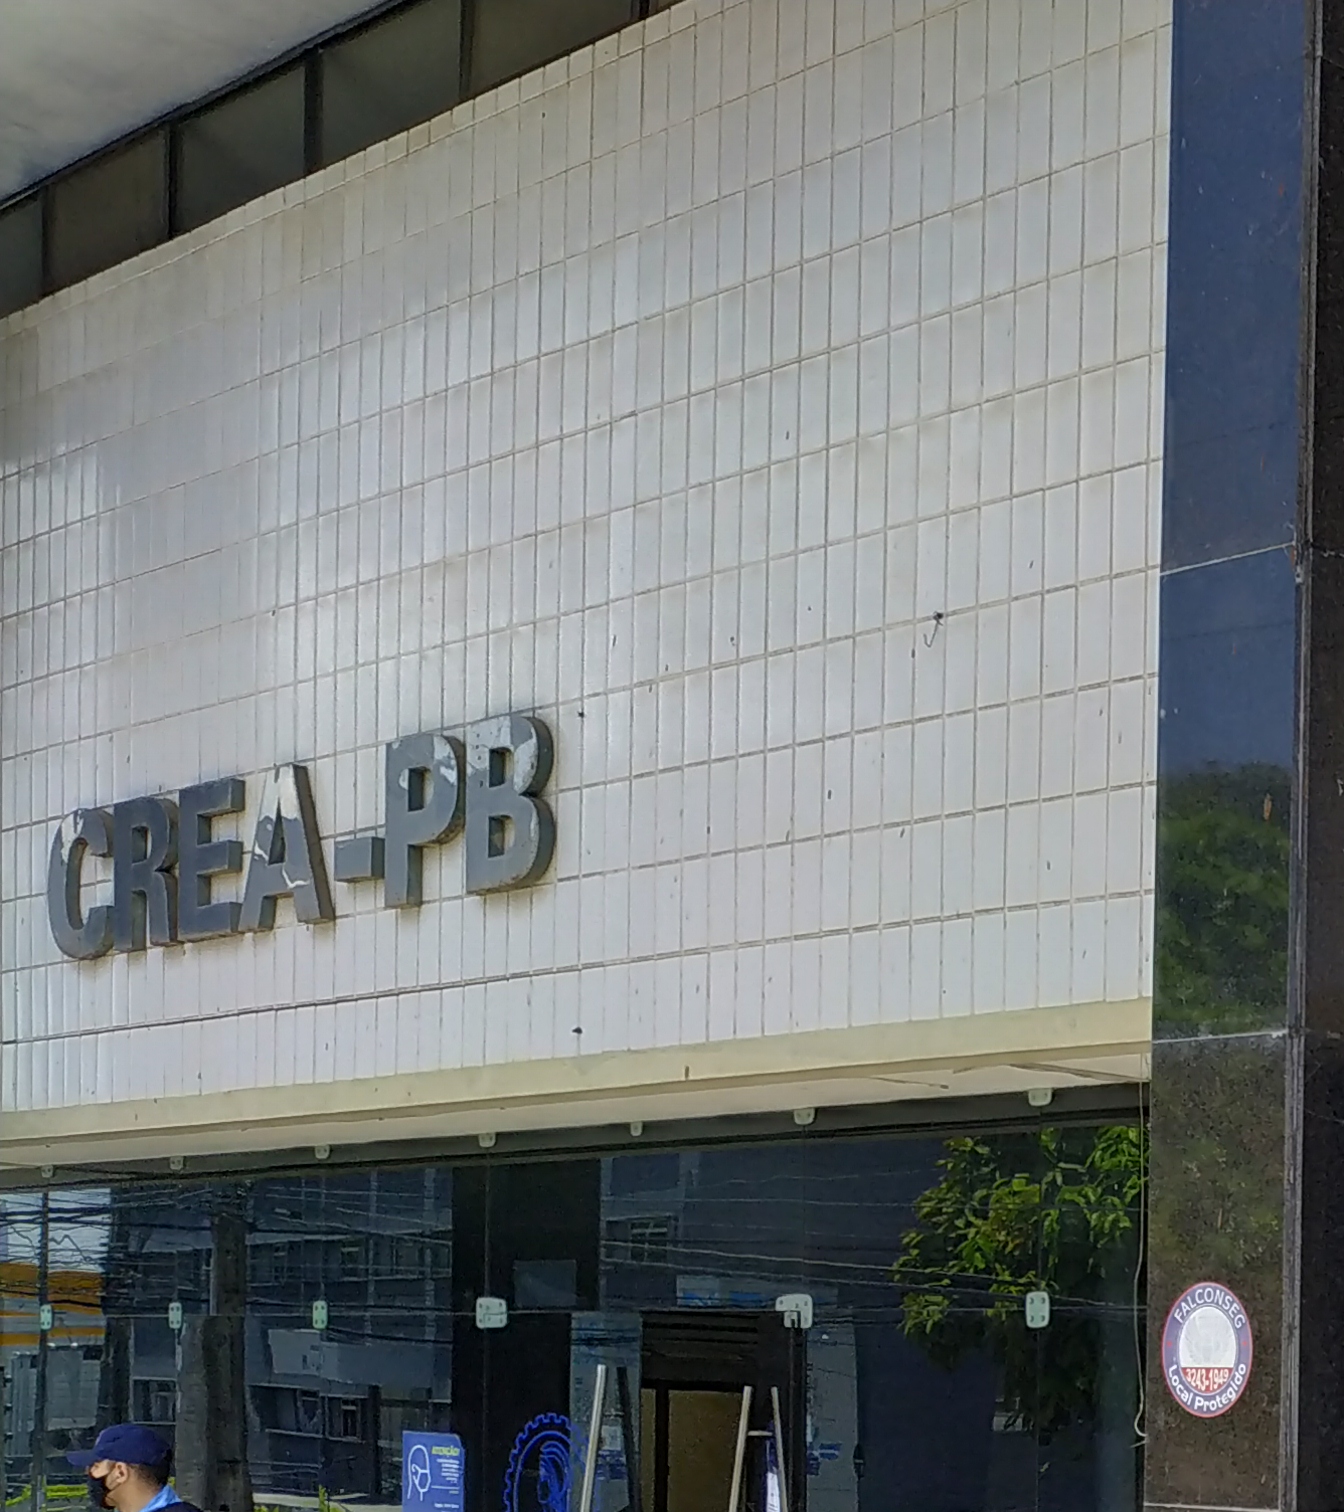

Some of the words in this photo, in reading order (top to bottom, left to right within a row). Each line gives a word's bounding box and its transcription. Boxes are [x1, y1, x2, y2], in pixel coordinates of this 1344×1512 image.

[47, 714, 558, 960] CREA-PB
[1173, 1287, 1246, 1329] FALCONSEG
[1168, 1363, 1194, 1406] Local
[1193, 1363, 1247, 1412] Protegido
[1185, 1368, 1230, 1391] 3243-1949
